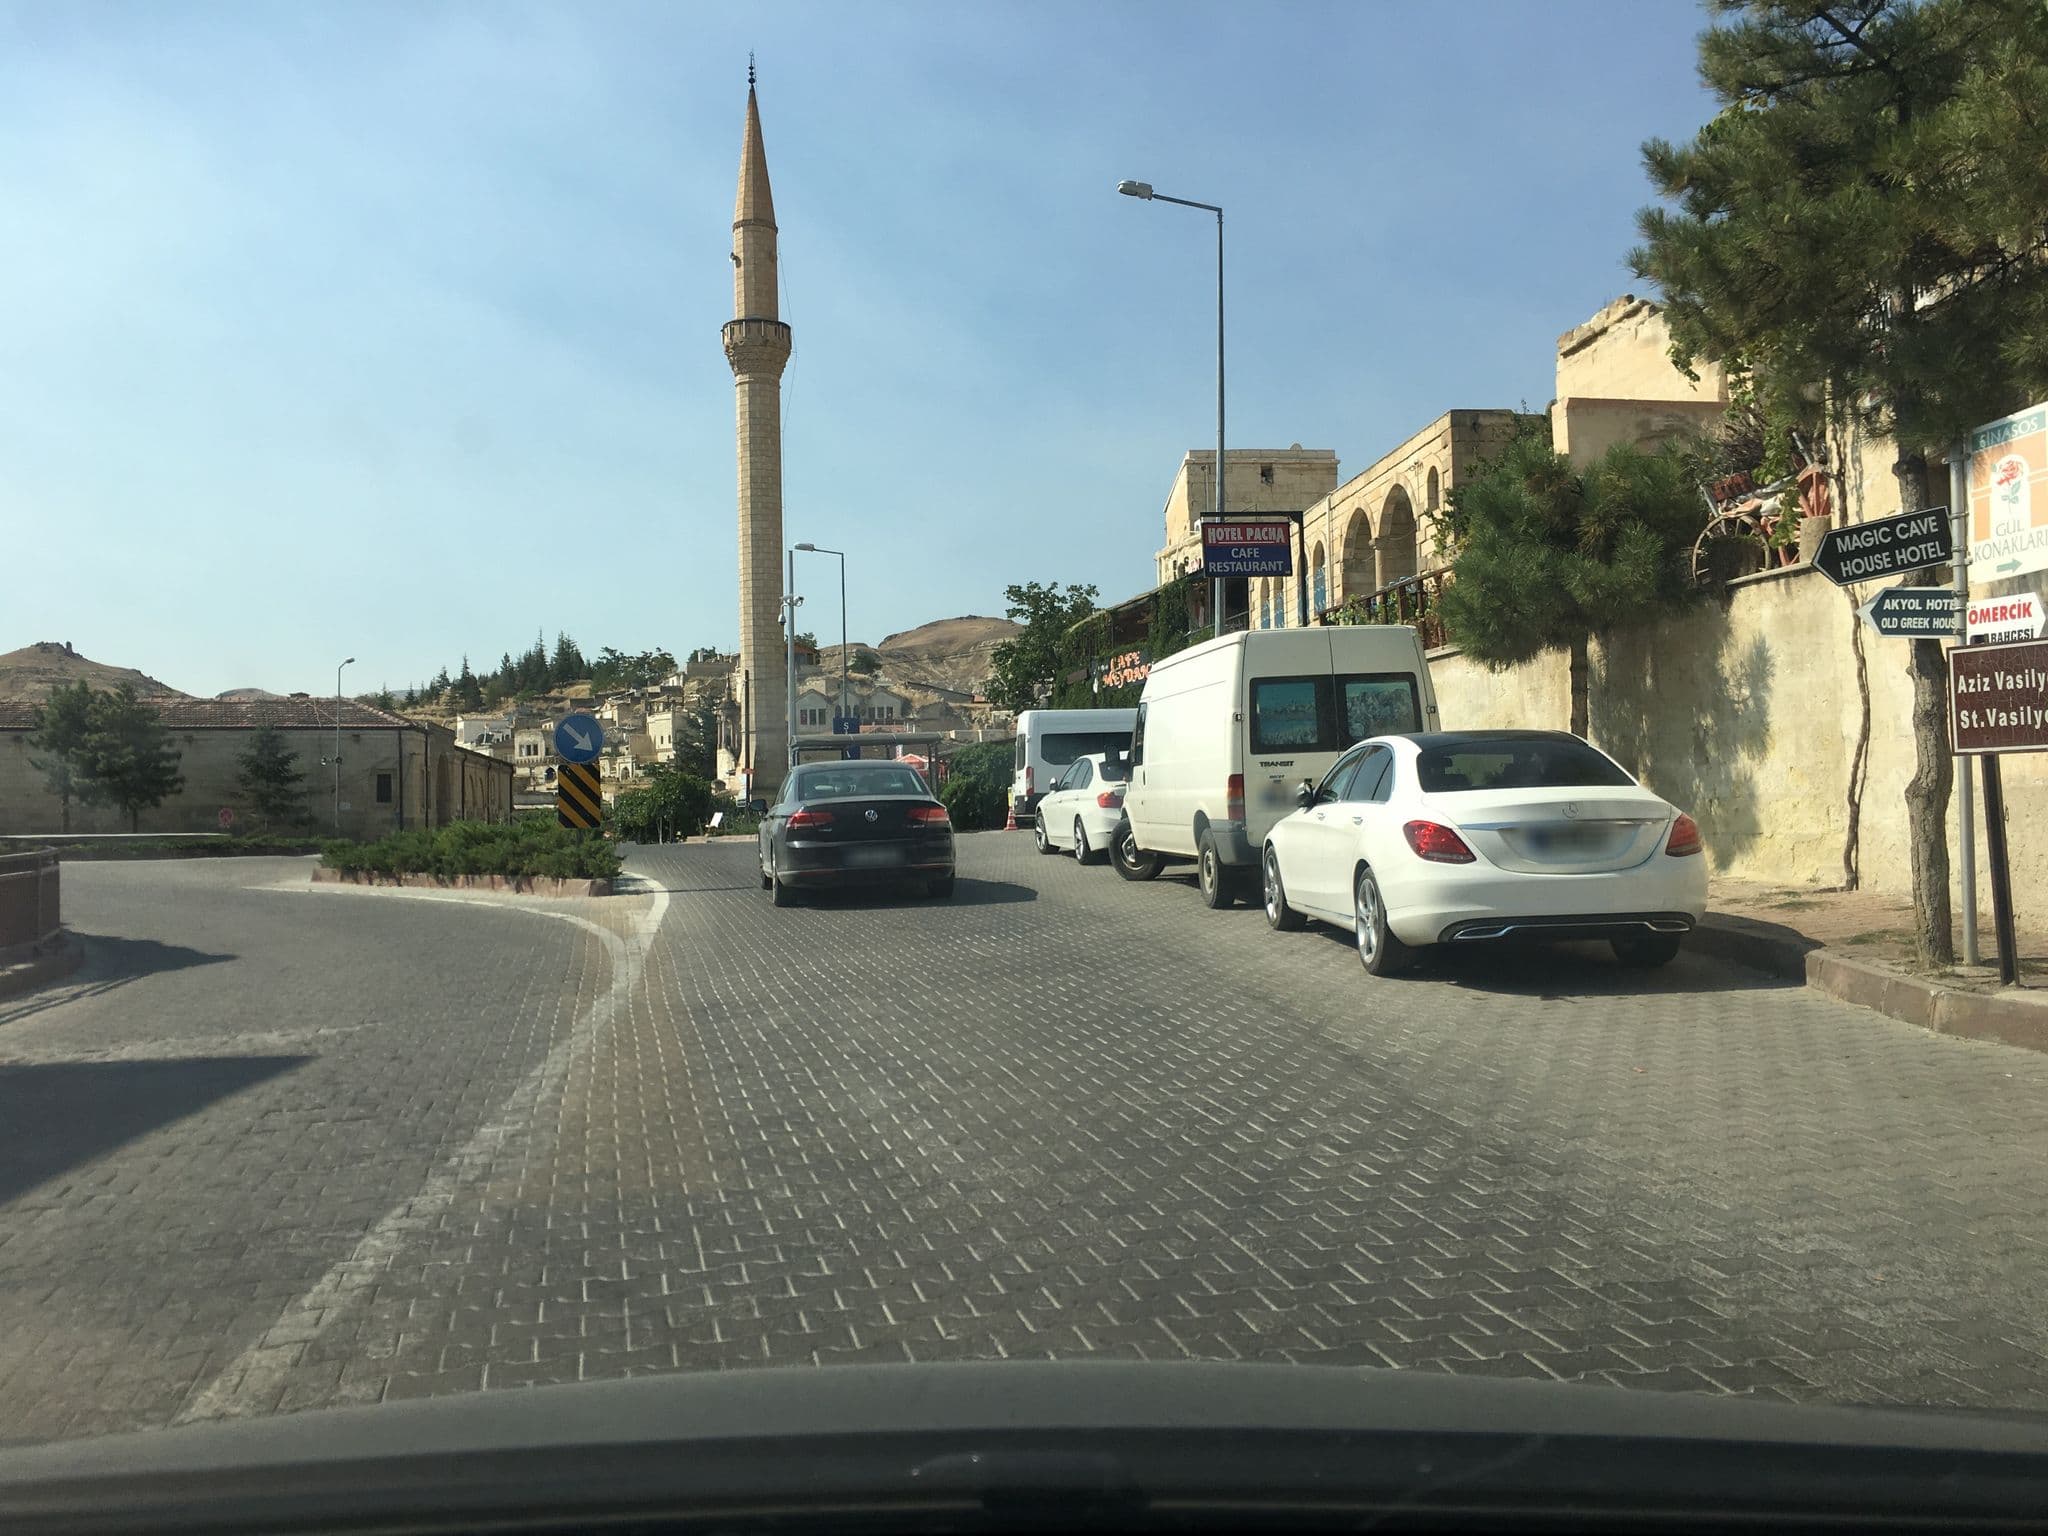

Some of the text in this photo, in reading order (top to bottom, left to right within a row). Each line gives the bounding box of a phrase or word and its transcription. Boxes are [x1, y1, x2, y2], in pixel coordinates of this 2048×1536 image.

[1207, 527, 1286, 544] HOTEL PACHA
[1836, 516, 1939, 553] MAGIC CAVE
[1231, 548, 1260, 558] CAFE
[1840, 541, 1946, 578] HOUSE HOTEL
[1208, 561, 1284, 573] RESTAURANT
[1883, 598, 1957, 611] AKYOL HOTE
[1968, 599, 2033, 625] ÖMERCİK
[1881, 617, 1957, 629] OLD GREEK HOUS
[1957, 668, 2048, 694] Aziz Vasily
